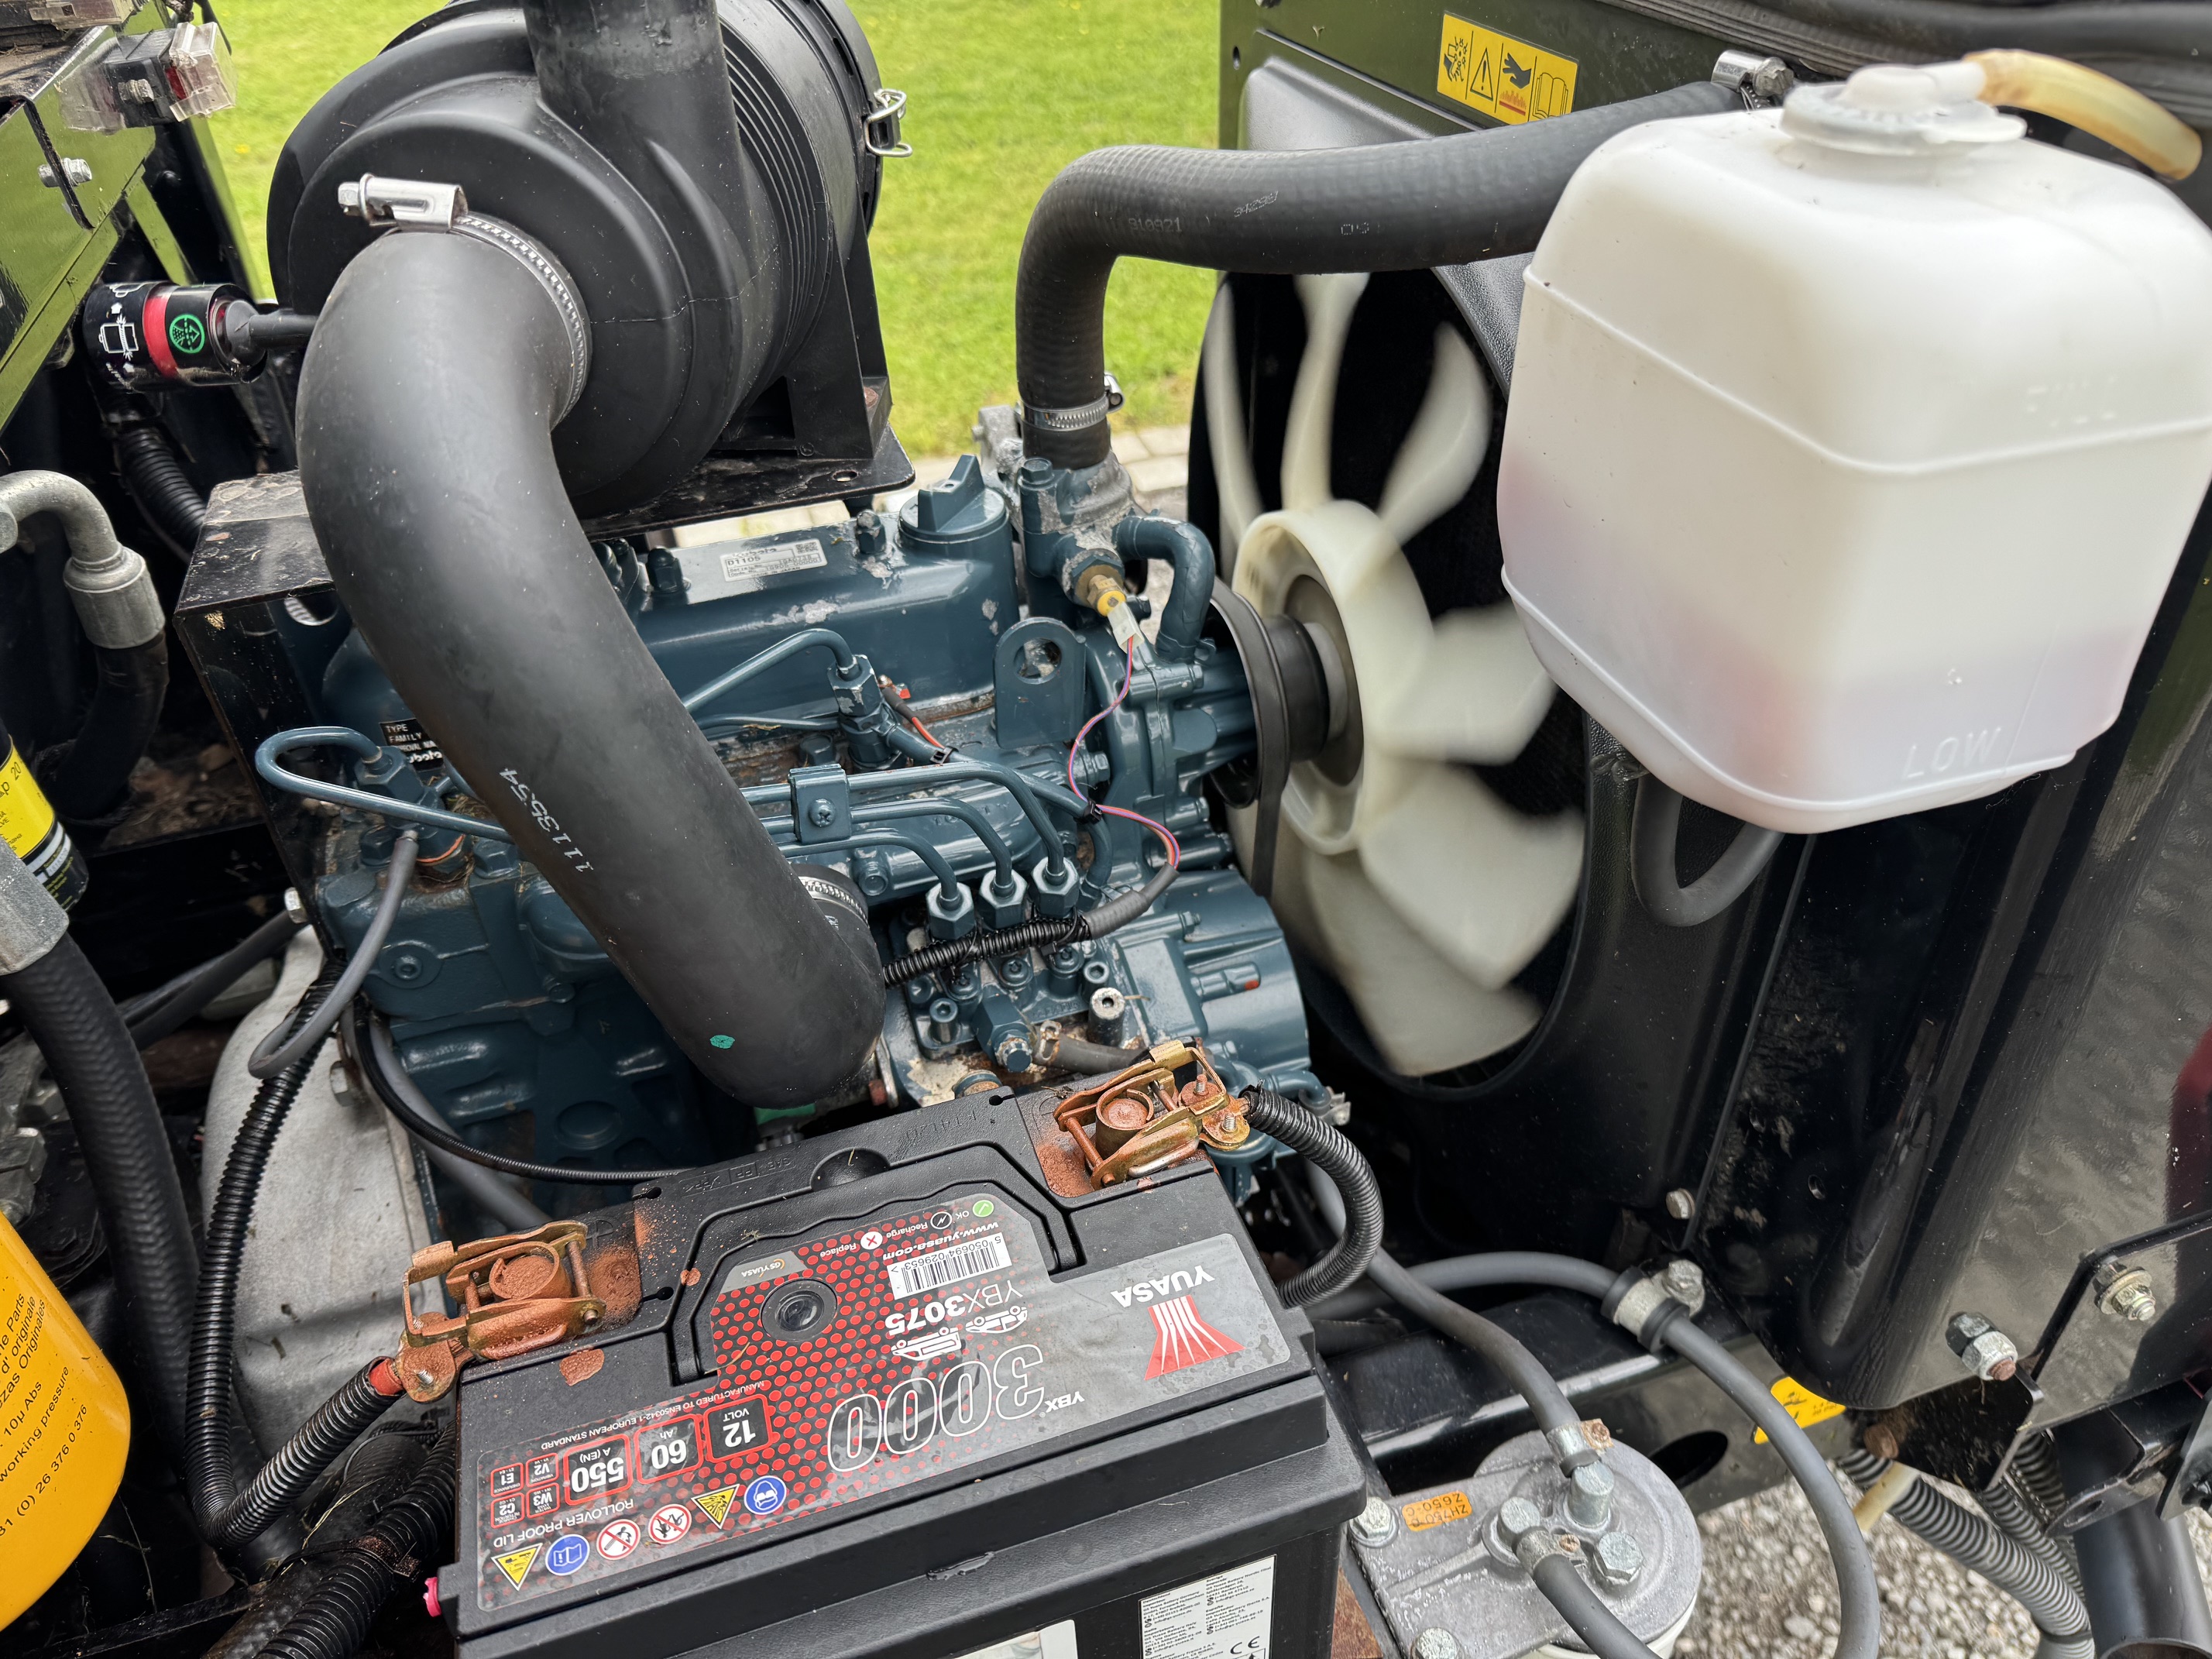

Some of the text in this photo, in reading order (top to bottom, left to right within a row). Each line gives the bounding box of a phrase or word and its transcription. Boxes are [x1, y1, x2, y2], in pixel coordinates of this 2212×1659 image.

[728, 557, 761, 565] D1105
[386, 724, 408, 733] TYPE
[389, 733, 422, 743] FAMILY
[407, 750, 442, 763] ubota
[1902, 726, 2002, 779] LOW
[11, 761, 22, 781] 20
[819, 1209, 970, 1259] OK Recharge Replace
[882, 1221, 1000, 1262] www.yuasa.com
[904, 1235, 1001, 1270] 5 050694 029653
[1111, 1265, 1215, 1308] YUASA
[6, 1293, 26, 1328] Parts
[884, 1279, 1023, 1337] YBX3075
[12, 1296, 36, 1356] originale
[19, 1299, 46, 1369] Originales
[25, 1381, 42, 1411] Abs
[827, 1344, 1044, 1472] 3000
[1044, 1391, 1085, 1413] YBX
[0, 1367, 69, 1482] working pressure
[541, 1380, 764, 1451] MANUFACTURED TO EN50342-1 EUROPEAN STANDARD
[723, 1407, 750, 1422] VOLT
[659, 1429, 674, 1441] Ah
[723, 1420, 756, 1448] 12
[17, 1495, 36, 1516] (0)
[36, 1473, 51, 1495] 26
[51, 1444, 70, 1472] 376
[68, 1432, 76, 1443] 0
[74, 1403, 88, 1431] 376
[534, 1463, 550, 1475] V2
[579, 1447, 611, 1464] A (EN)
[651, 1439, 687, 1469] 60
[494, 1482, 520, 1493] ENDURANCE
[501, 1472, 514, 1486] E1
[571, 1457, 625, 1492] 550
[500, 1503, 515, 1516] C2
[533, 1492, 552, 1506] W3
[493, 1497, 634, 1548] ROLLOVER PROOF LID
